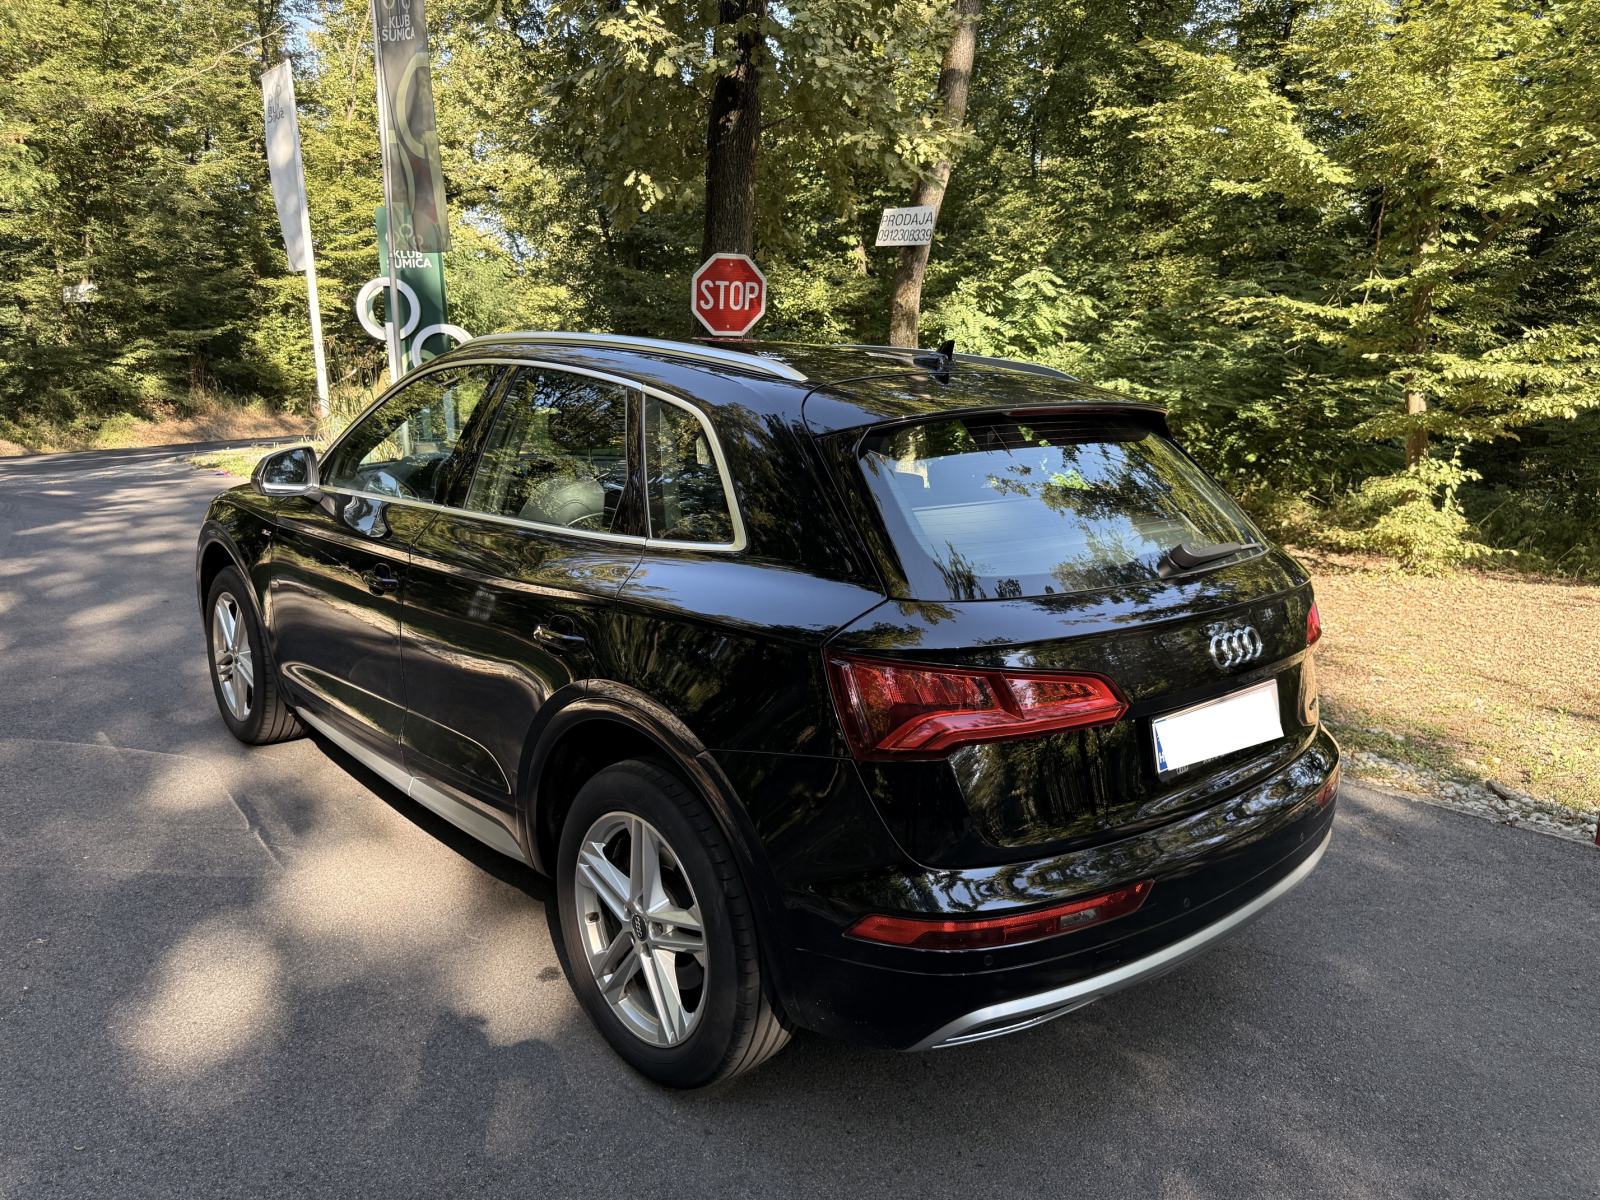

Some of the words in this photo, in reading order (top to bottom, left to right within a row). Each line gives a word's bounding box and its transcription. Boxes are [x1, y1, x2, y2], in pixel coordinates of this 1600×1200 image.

[388, 14, 411, 29] KLUB
[880, 211, 933, 227] PRODAJA
[387, 257, 433, 269] UMICA
[700, 280, 759, 311] STOP
